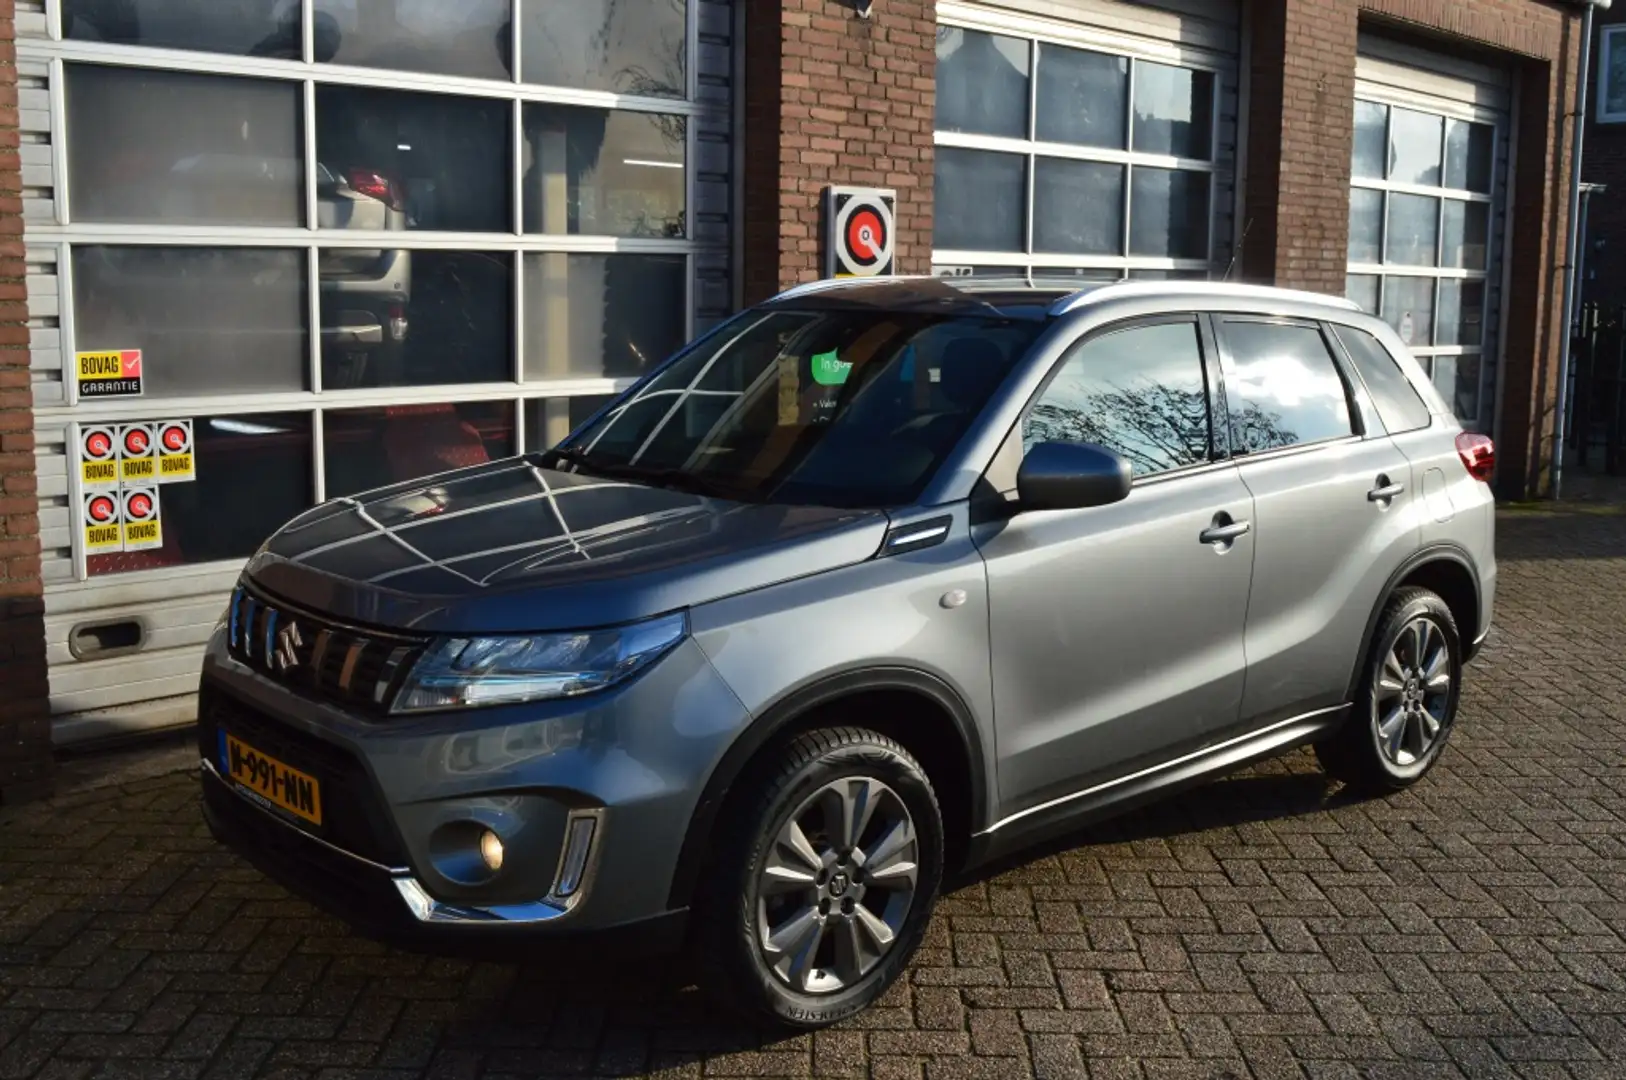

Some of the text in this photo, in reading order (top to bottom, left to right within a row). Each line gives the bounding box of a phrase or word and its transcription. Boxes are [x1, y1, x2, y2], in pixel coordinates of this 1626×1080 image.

[81, 355, 119, 375] BOVAG
[82, 381, 138, 394] GARANTIE
[85, 463, 115, 479] BOVAG
[124, 460, 153, 476] BOVAG
[162, 457, 190, 472] BOVAG
[89, 527, 118, 543] BOVAG
[128, 524, 156, 540] BOVAG
